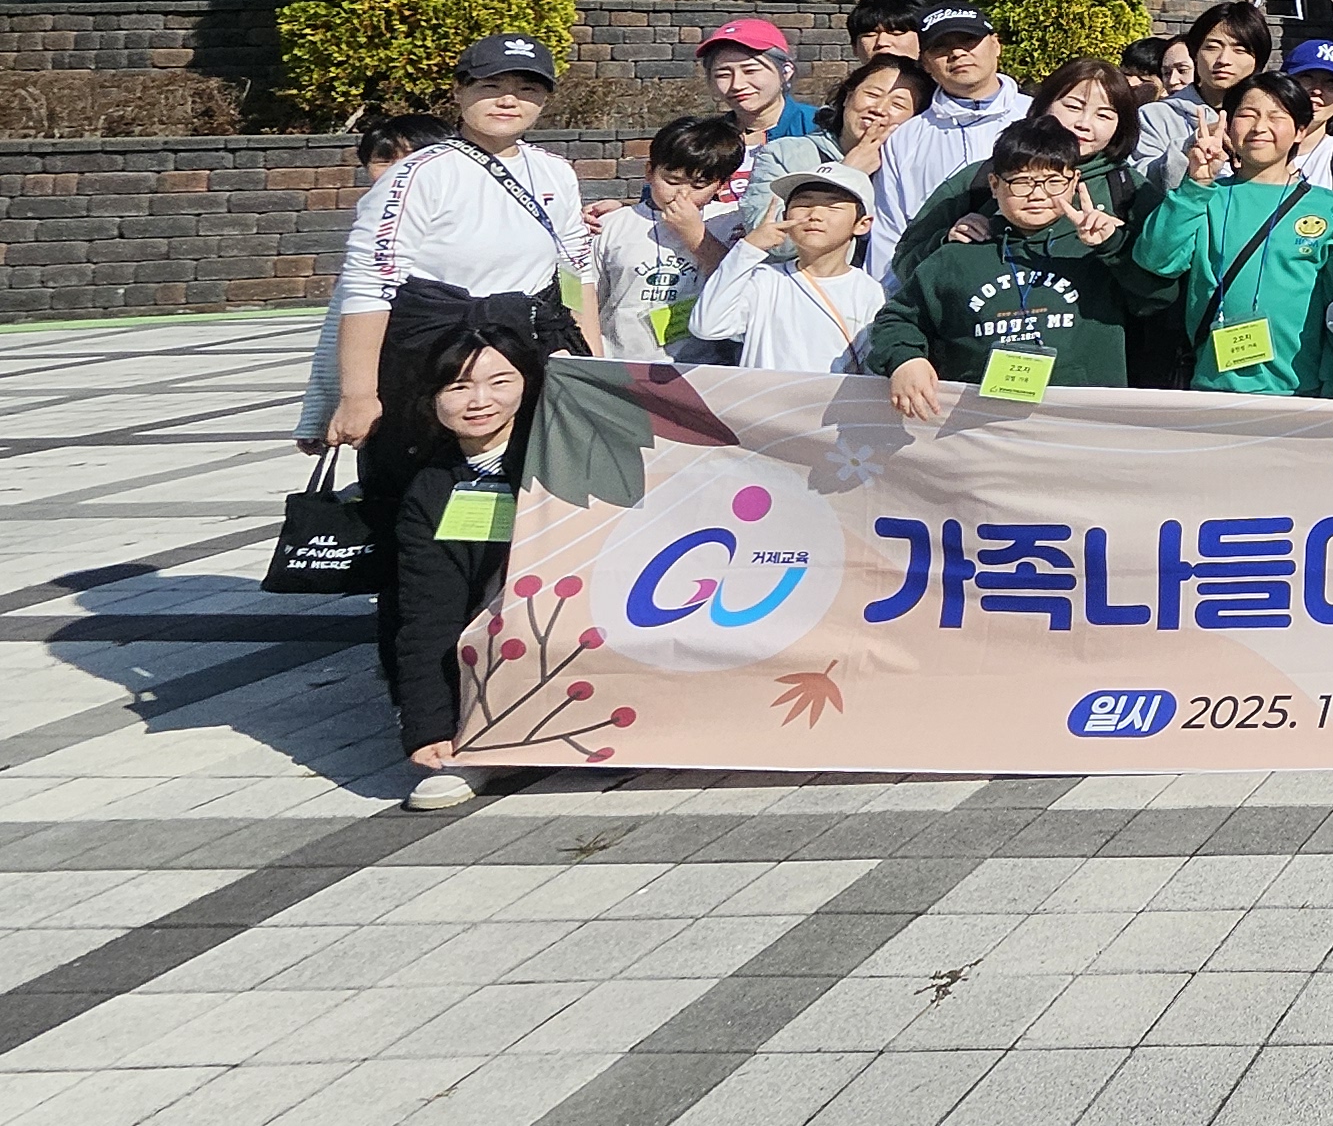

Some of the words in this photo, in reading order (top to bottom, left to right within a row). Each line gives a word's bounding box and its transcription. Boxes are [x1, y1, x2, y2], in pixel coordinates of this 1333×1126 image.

[974, 316, 1037, 337] ABOUT
[1046, 313, 1075, 328] ME
[308, 536, 338, 545] ALL
[286, 560, 307, 569] IN
[310, 560, 352, 569] HERE
[751, 550, 810, 565] 거제교육
[1083, 696, 1162, 733] 일시
[1180, 695, 1298, 729] 2025.
